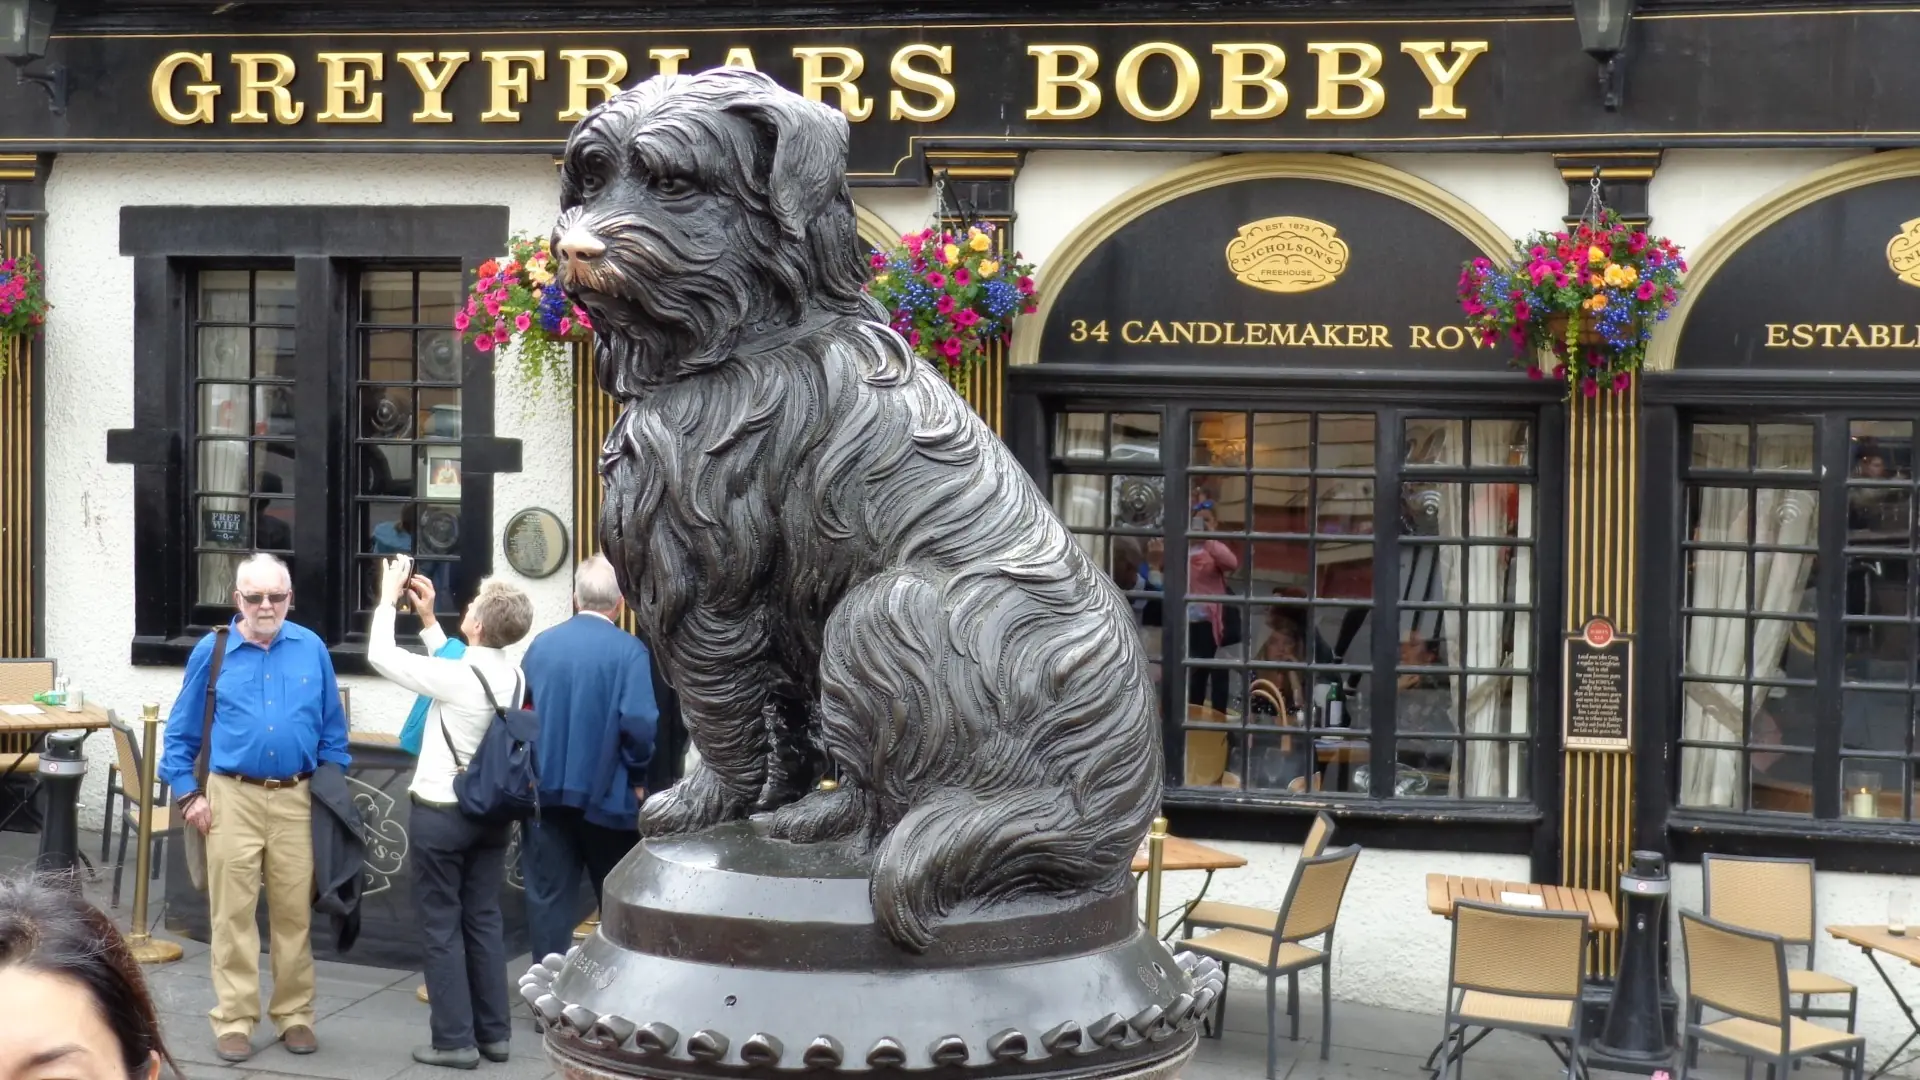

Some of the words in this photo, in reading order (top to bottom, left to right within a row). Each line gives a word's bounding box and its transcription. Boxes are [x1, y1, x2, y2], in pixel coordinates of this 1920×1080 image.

[1025, 41, 1489, 121] BOBBY
[1265, 222, 1284, 232] EST.
[1289, 222, 1310, 232] 1873
[1242, 242, 1333, 265] NICHOLSON'S
[1261, 269, 1313, 277] FREEHOUSE
[1070, 319, 1109, 344] 34
[1121, 320, 1393, 349] CANDLEMAKER
[212, 512, 241, 522] FREE
[212, 521, 240, 531] WIFI
